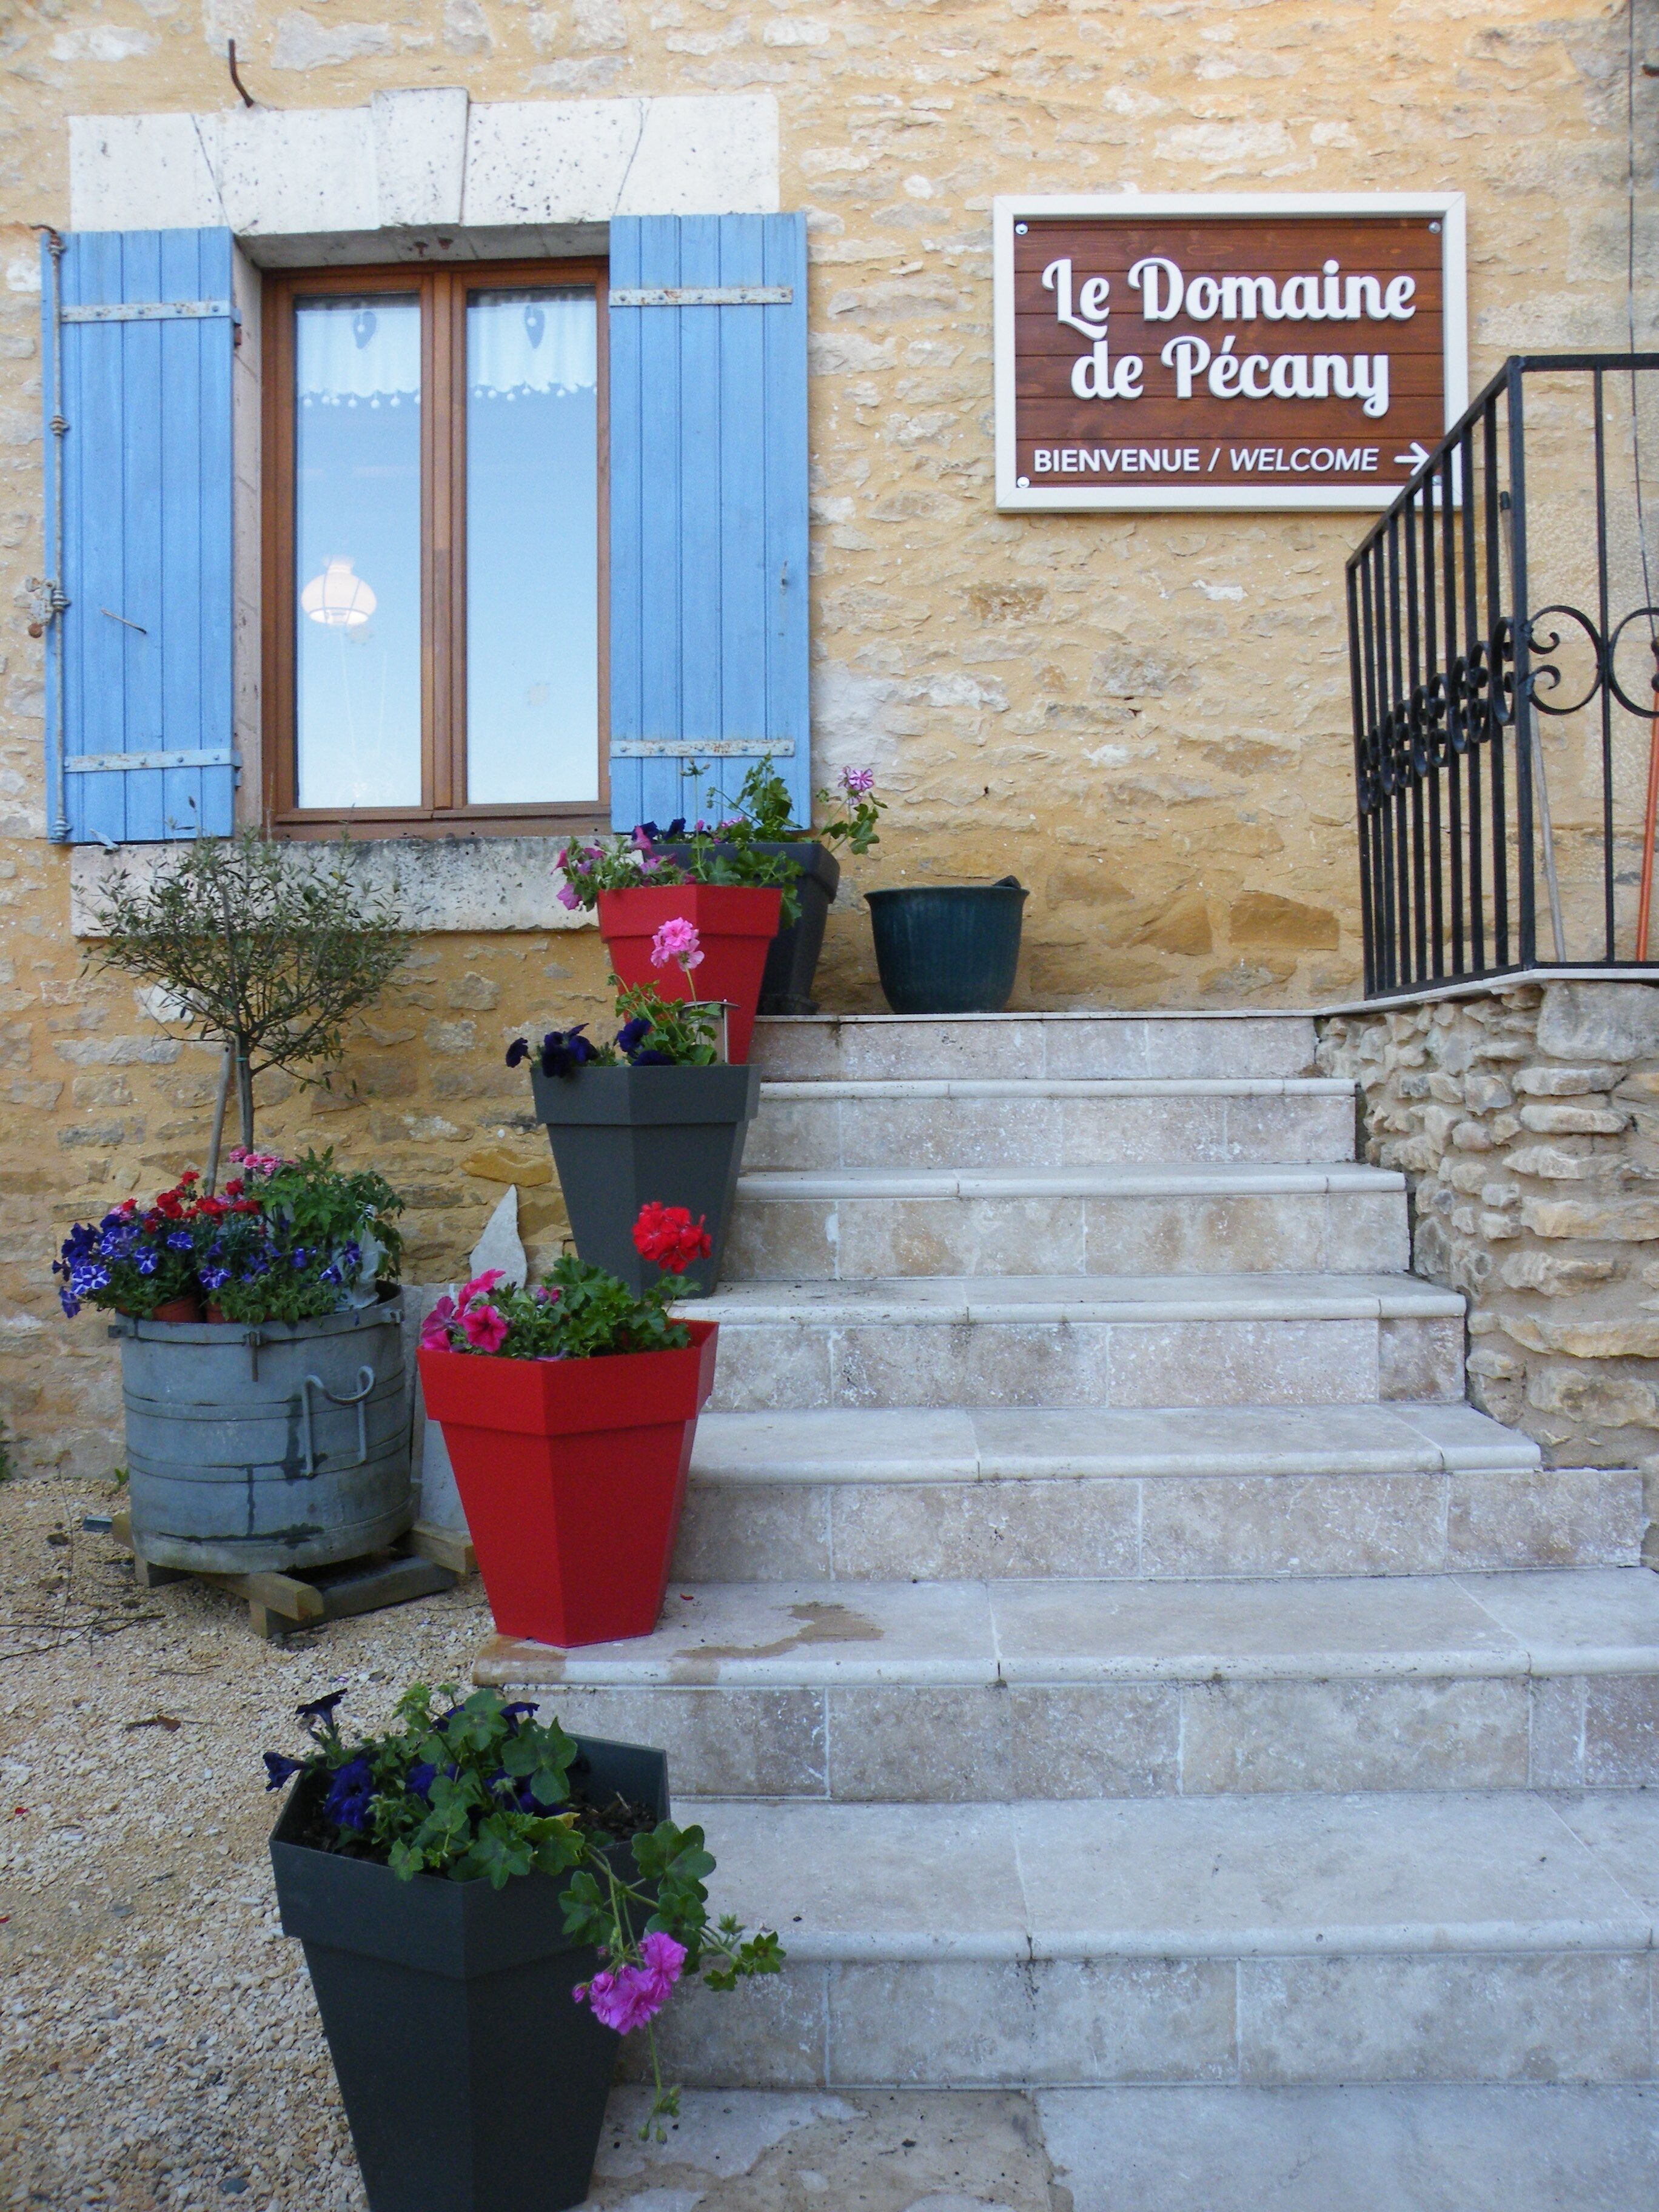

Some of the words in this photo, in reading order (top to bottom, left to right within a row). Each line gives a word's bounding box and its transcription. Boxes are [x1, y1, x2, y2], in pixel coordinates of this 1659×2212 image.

[1041, 258, 1110, 341] Le
[1127, 257, 1416, 321] Domaine
[1070, 340, 1144, 400] de
[1161, 335, 1390, 419] Pécany
[1034, 448, 1201, 473] BIENVENUE
[1207, 447, 1221, 473] /
[1230, 447, 1379, 473] WELCOME
